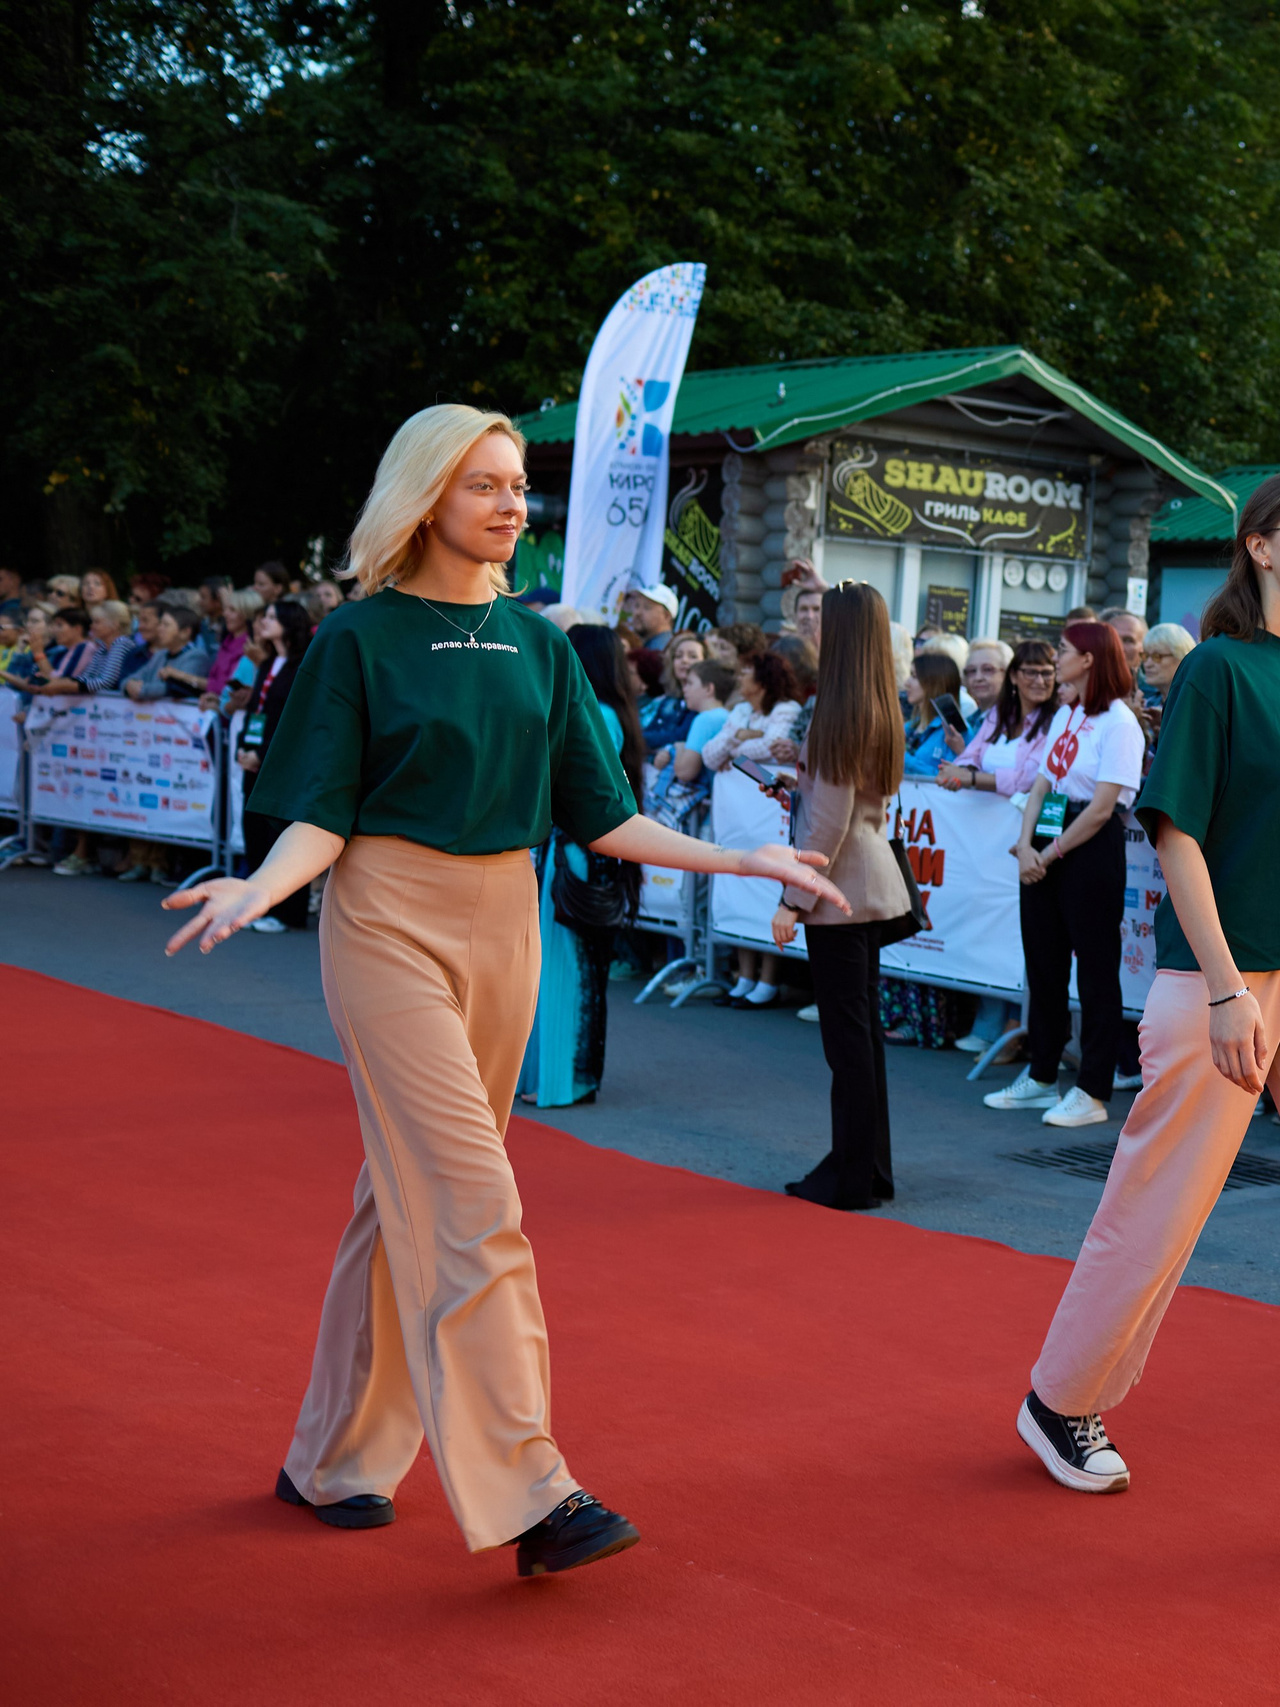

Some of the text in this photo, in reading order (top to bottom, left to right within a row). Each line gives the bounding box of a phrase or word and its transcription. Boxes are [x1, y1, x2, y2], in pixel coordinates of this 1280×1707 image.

[609, 473, 655, 491] КИРО
[884, 458, 1083, 511] SHAUROOM
[607, 497, 649, 527] 65
[924, 500, 1027, 528] ГРИЛЬ КАФЕ
[431, 641, 519, 654] делаю что нравится
